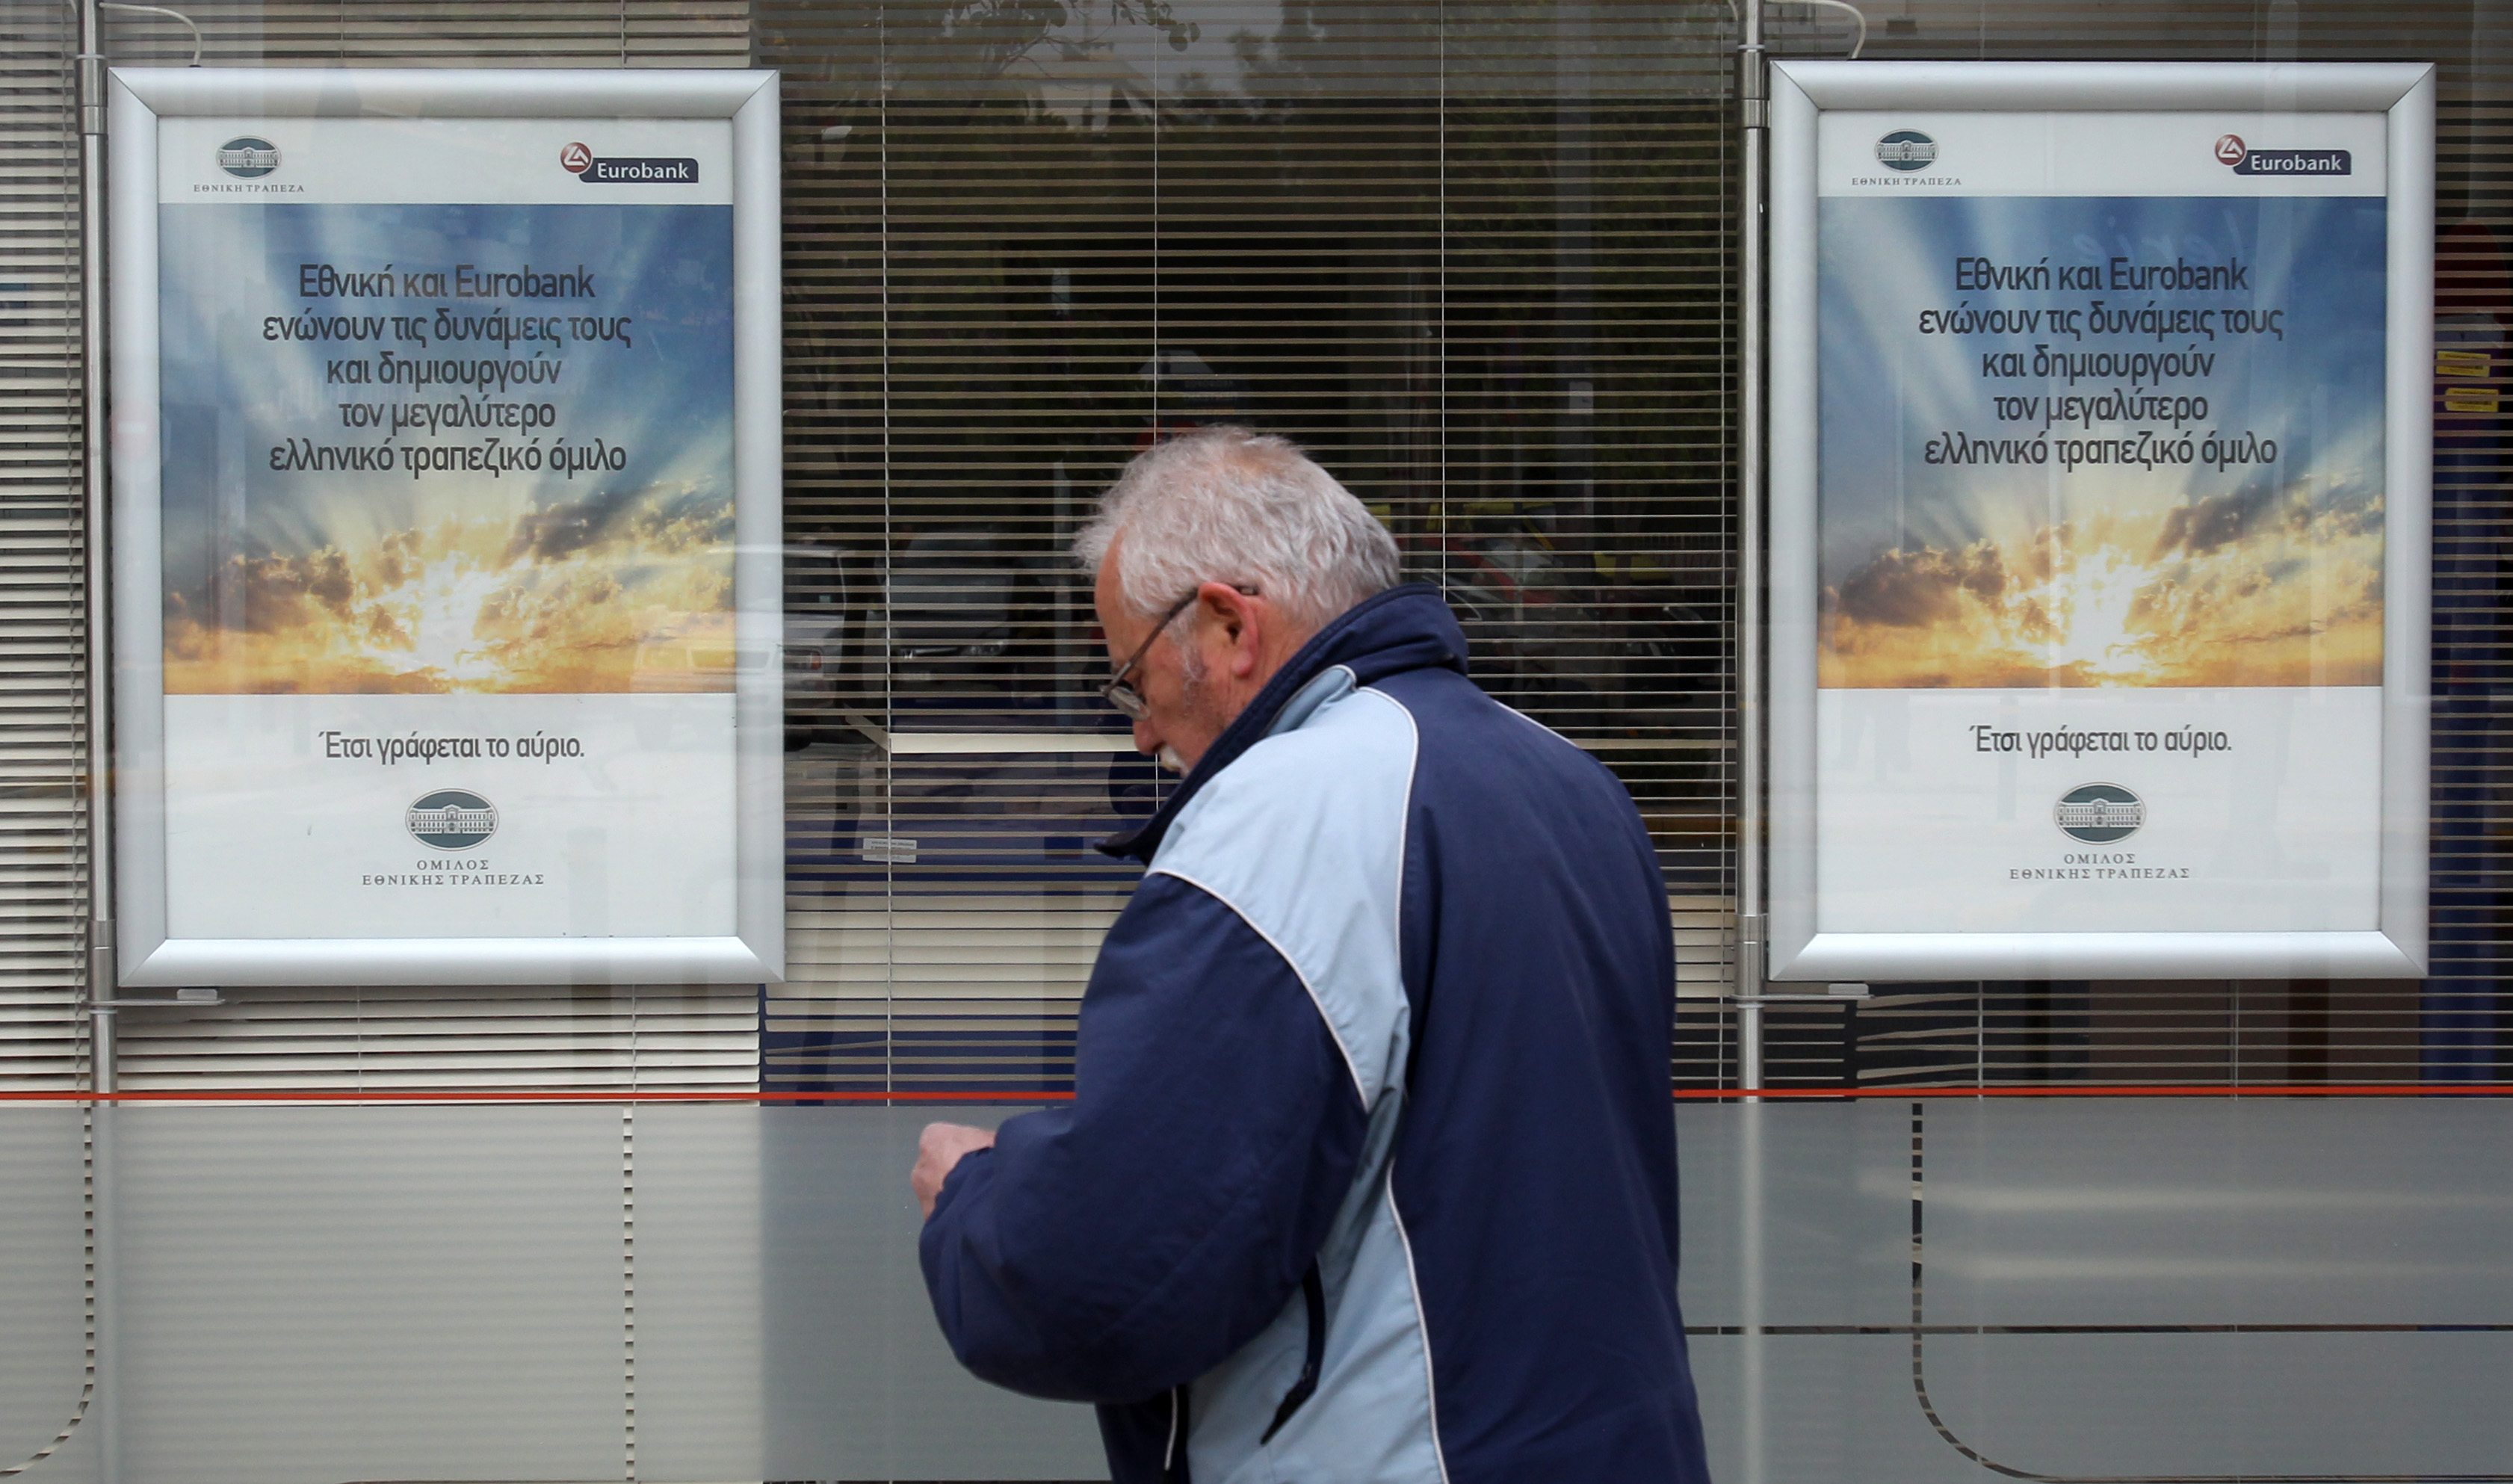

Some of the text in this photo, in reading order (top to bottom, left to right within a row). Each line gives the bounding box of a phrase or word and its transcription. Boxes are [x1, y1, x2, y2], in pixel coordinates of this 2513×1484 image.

[596, 162, 690, 179] Eurobank
[2250, 154, 2342, 171] Eurobank
[193, 185, 305, 193] ΕΘΝΙΚΗ ΤΡΑΠΕΖΑ
[1852, 178, 1962, 186] ΕΘΝΙΚΗ ΤΡΑΠΕΖΑ
[300, 265, 596, 298] Εθνική και Eurobank
[1956, 257, 2248, 291] Εθνική και Eurobank
[262, 309, 631, 347] ενώνουν τις δυνάμεις τους
[1918, 301, 2283, 341] ενώνουν τις δυνάμεις τους
[327, 351, 562, 391] και δημιουργούν
[1983, 344, 2216, 384] και δημιουργούν
[339, 395, 555, 435] τον μεγαλύτερο
[1994, 389, 2207, 428] τον μεγαλύτερο
[269, 438, 625, 478] ελληνικό τραπεζικό όμιλο
[1925, 431, 2277, 472] ελληνικό τραπεζικό όμιλο
[318, 731, 585, 764] Έτσι γράφεται το αύριο.
[1969, 725, 2231, 758] Έτσι γράφεται το αύριο.
[416, 859, 489, 871] ΟΜΙΛΟΣ
[2010, 868, 2190, 879] ΕΘΝΙΚΗΣ ΤΡΑΠΕΖΑΣ
[2064, 853, 2136, 865] ΟΜΙΛΟΣ
[362, 874, 544, 885] ΕΘΝΙΚΗΣ ΤΡΑΠΕΖΑΣ
